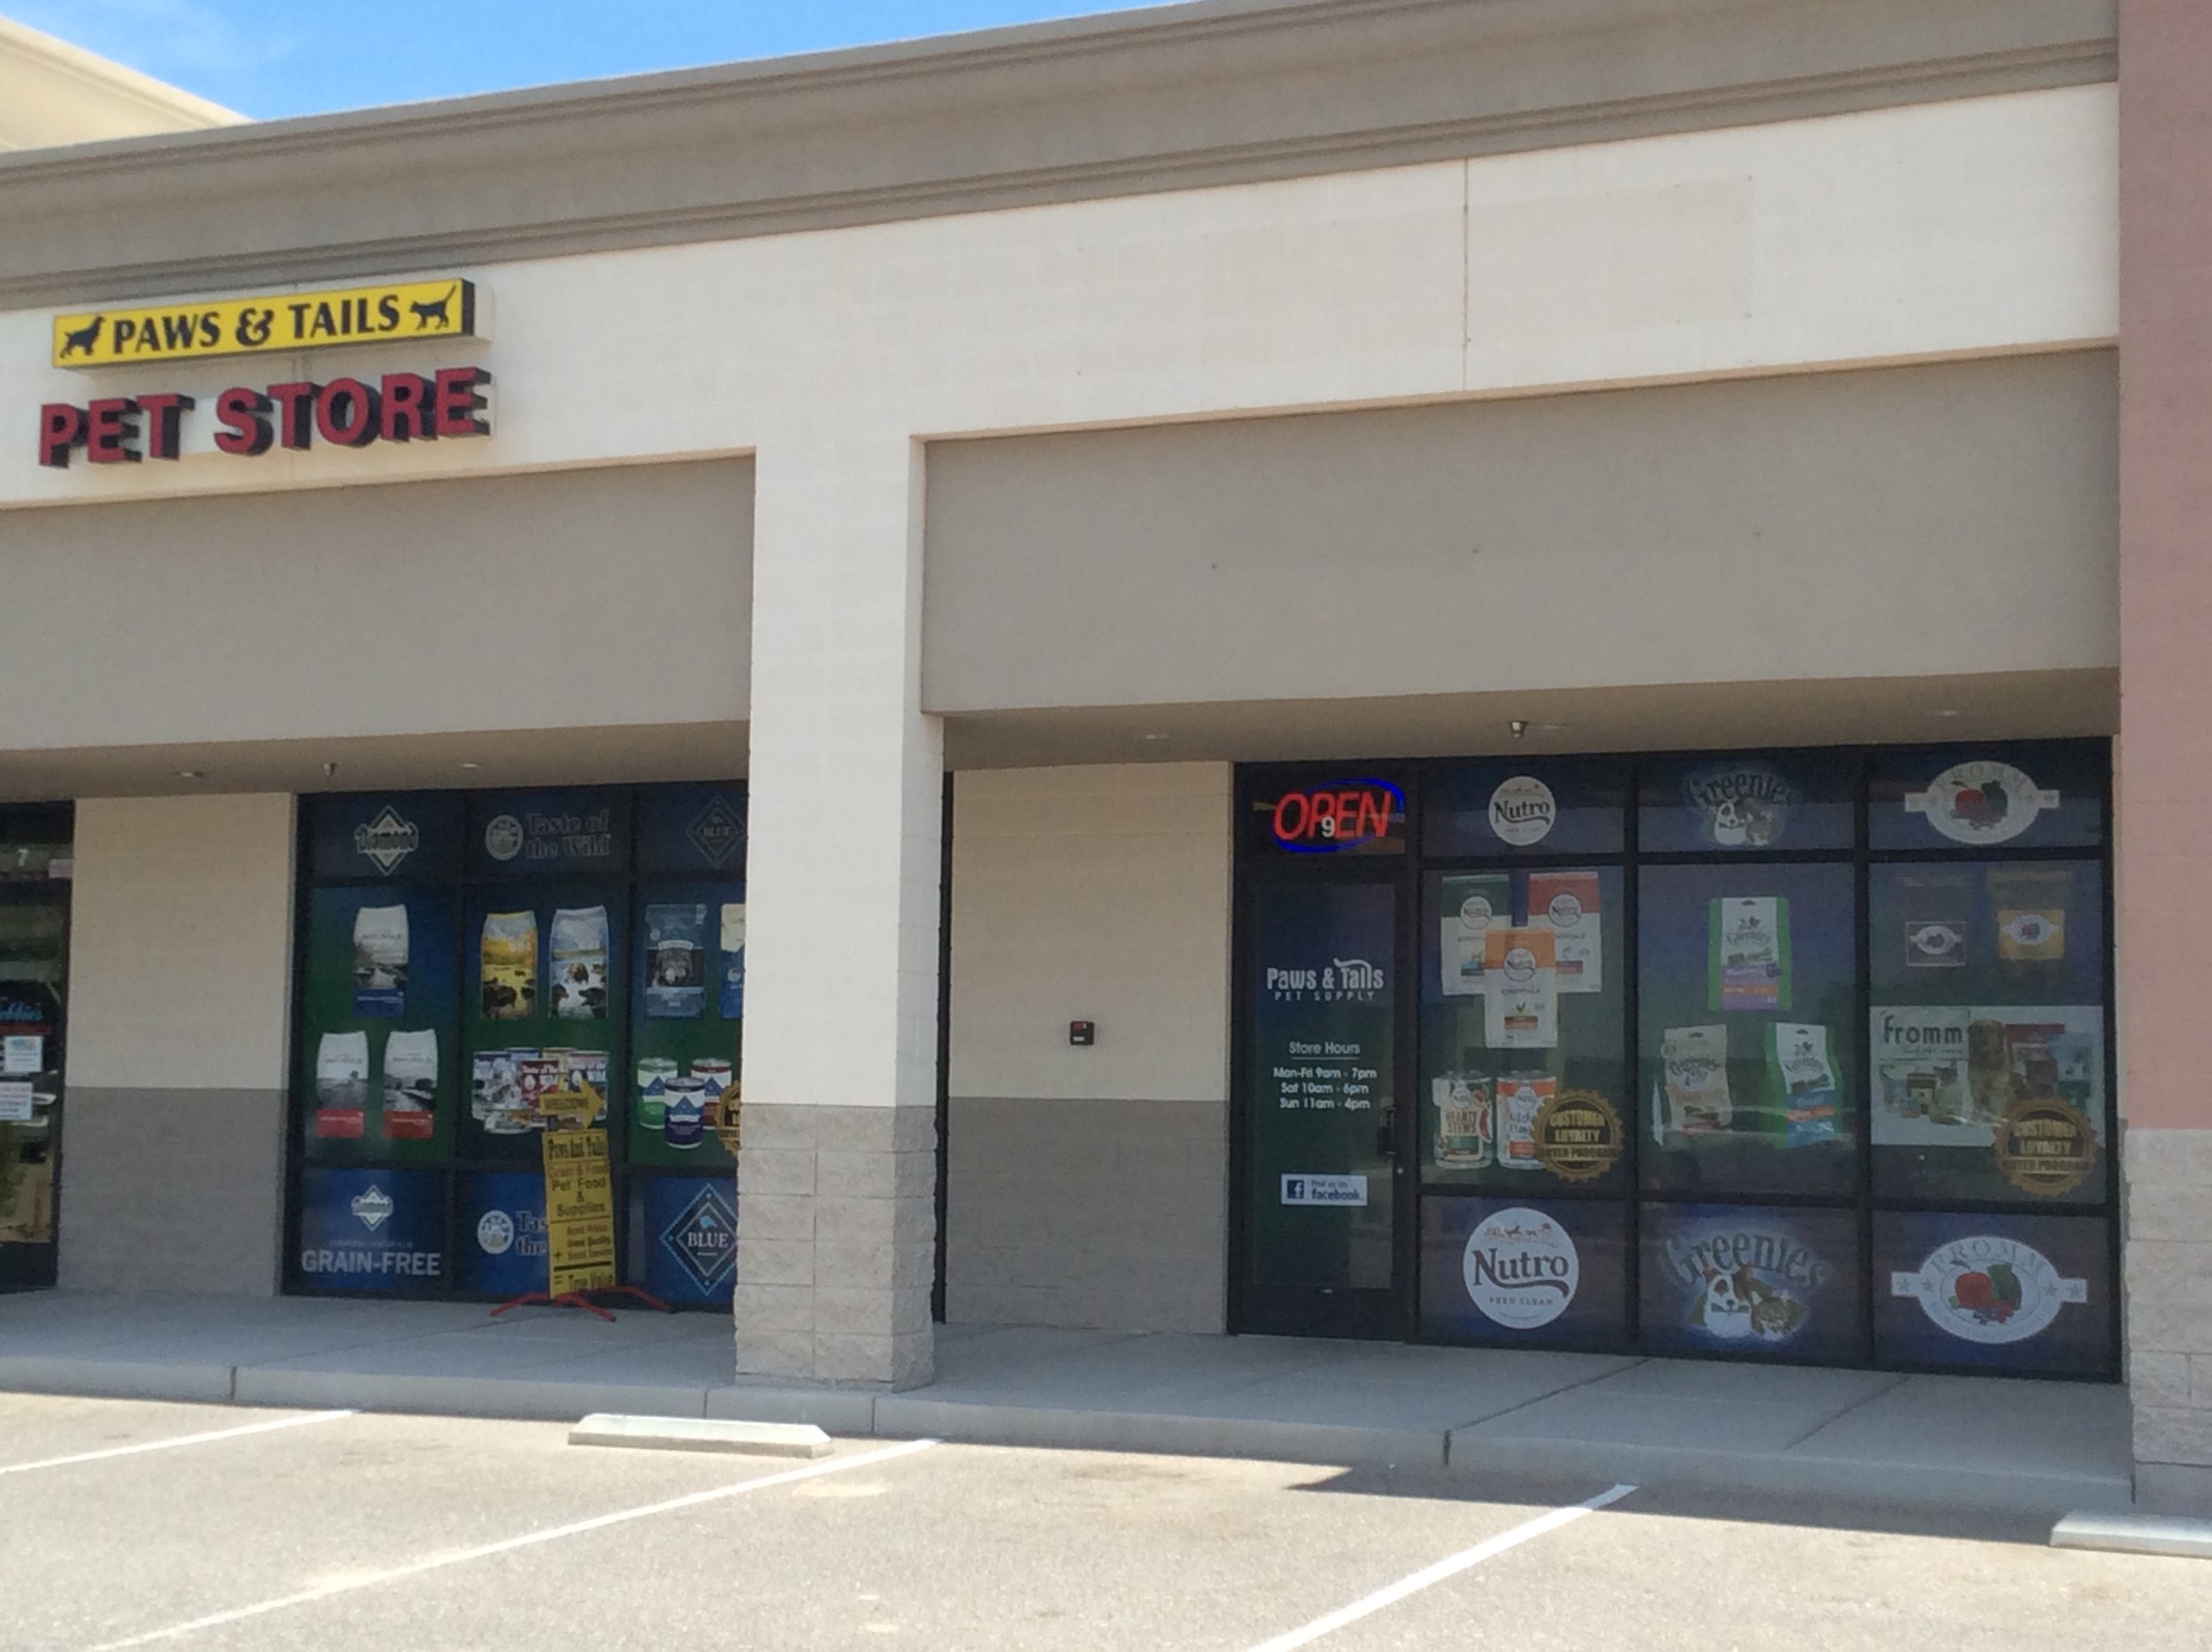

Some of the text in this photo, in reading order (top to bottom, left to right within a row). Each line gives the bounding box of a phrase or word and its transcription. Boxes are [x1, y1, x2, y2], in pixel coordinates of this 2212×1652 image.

[113, 294, 401, 355] PAWS & TAILS
[39, 366, 483, 468] PET STORE
[526, 809, 610, 835] Taste of
[1273, 790, 1393, 841] OPEN
[1493, 800, 1551, 826] Nutro
[1321, 815, 1336, 839] 9
[525, 833, 612, 859] the Wild
[1266, 958, 1384, 991] Paws & Tails
[1274, 991, 1375, 1002] PET SUPPLY
[1883, 1015, 1963, 1045] fromm
[1289, 1041, 1360, 1055] Store Hours
[1272, 1067, 1313, 1079] Mon-Fri
[1315, 1067, 1342, 1079] 9am
[1352, 1067, 1377, 1080] 7pm
[1281, 1081, 1299, 1094] Sat
[1302, 1081, 1333, 1094] 10am
[1343, 1082, 1369, 1096] 6pm
[1279, 1097, 1299, 1109] Sun
[1304, 1097, 1334, 1109] 11am
[1344, 1097, 1371, 1111] 4pm
[552, 1177, 606, 1192] Pet Food
[577, 1191, 585, 1202] &
[1312, 1188, 1360, 1201] facebook
[556, 1202, 605, 1217] Supplies
[687, 1231, 730, 1248] BLUE
[301, 1248, 441, 1277] GRAIN-FREE
[1470, 1247, 1570, 1298] Nutro
[1661, 1232, 1831, 1290] Greenies
